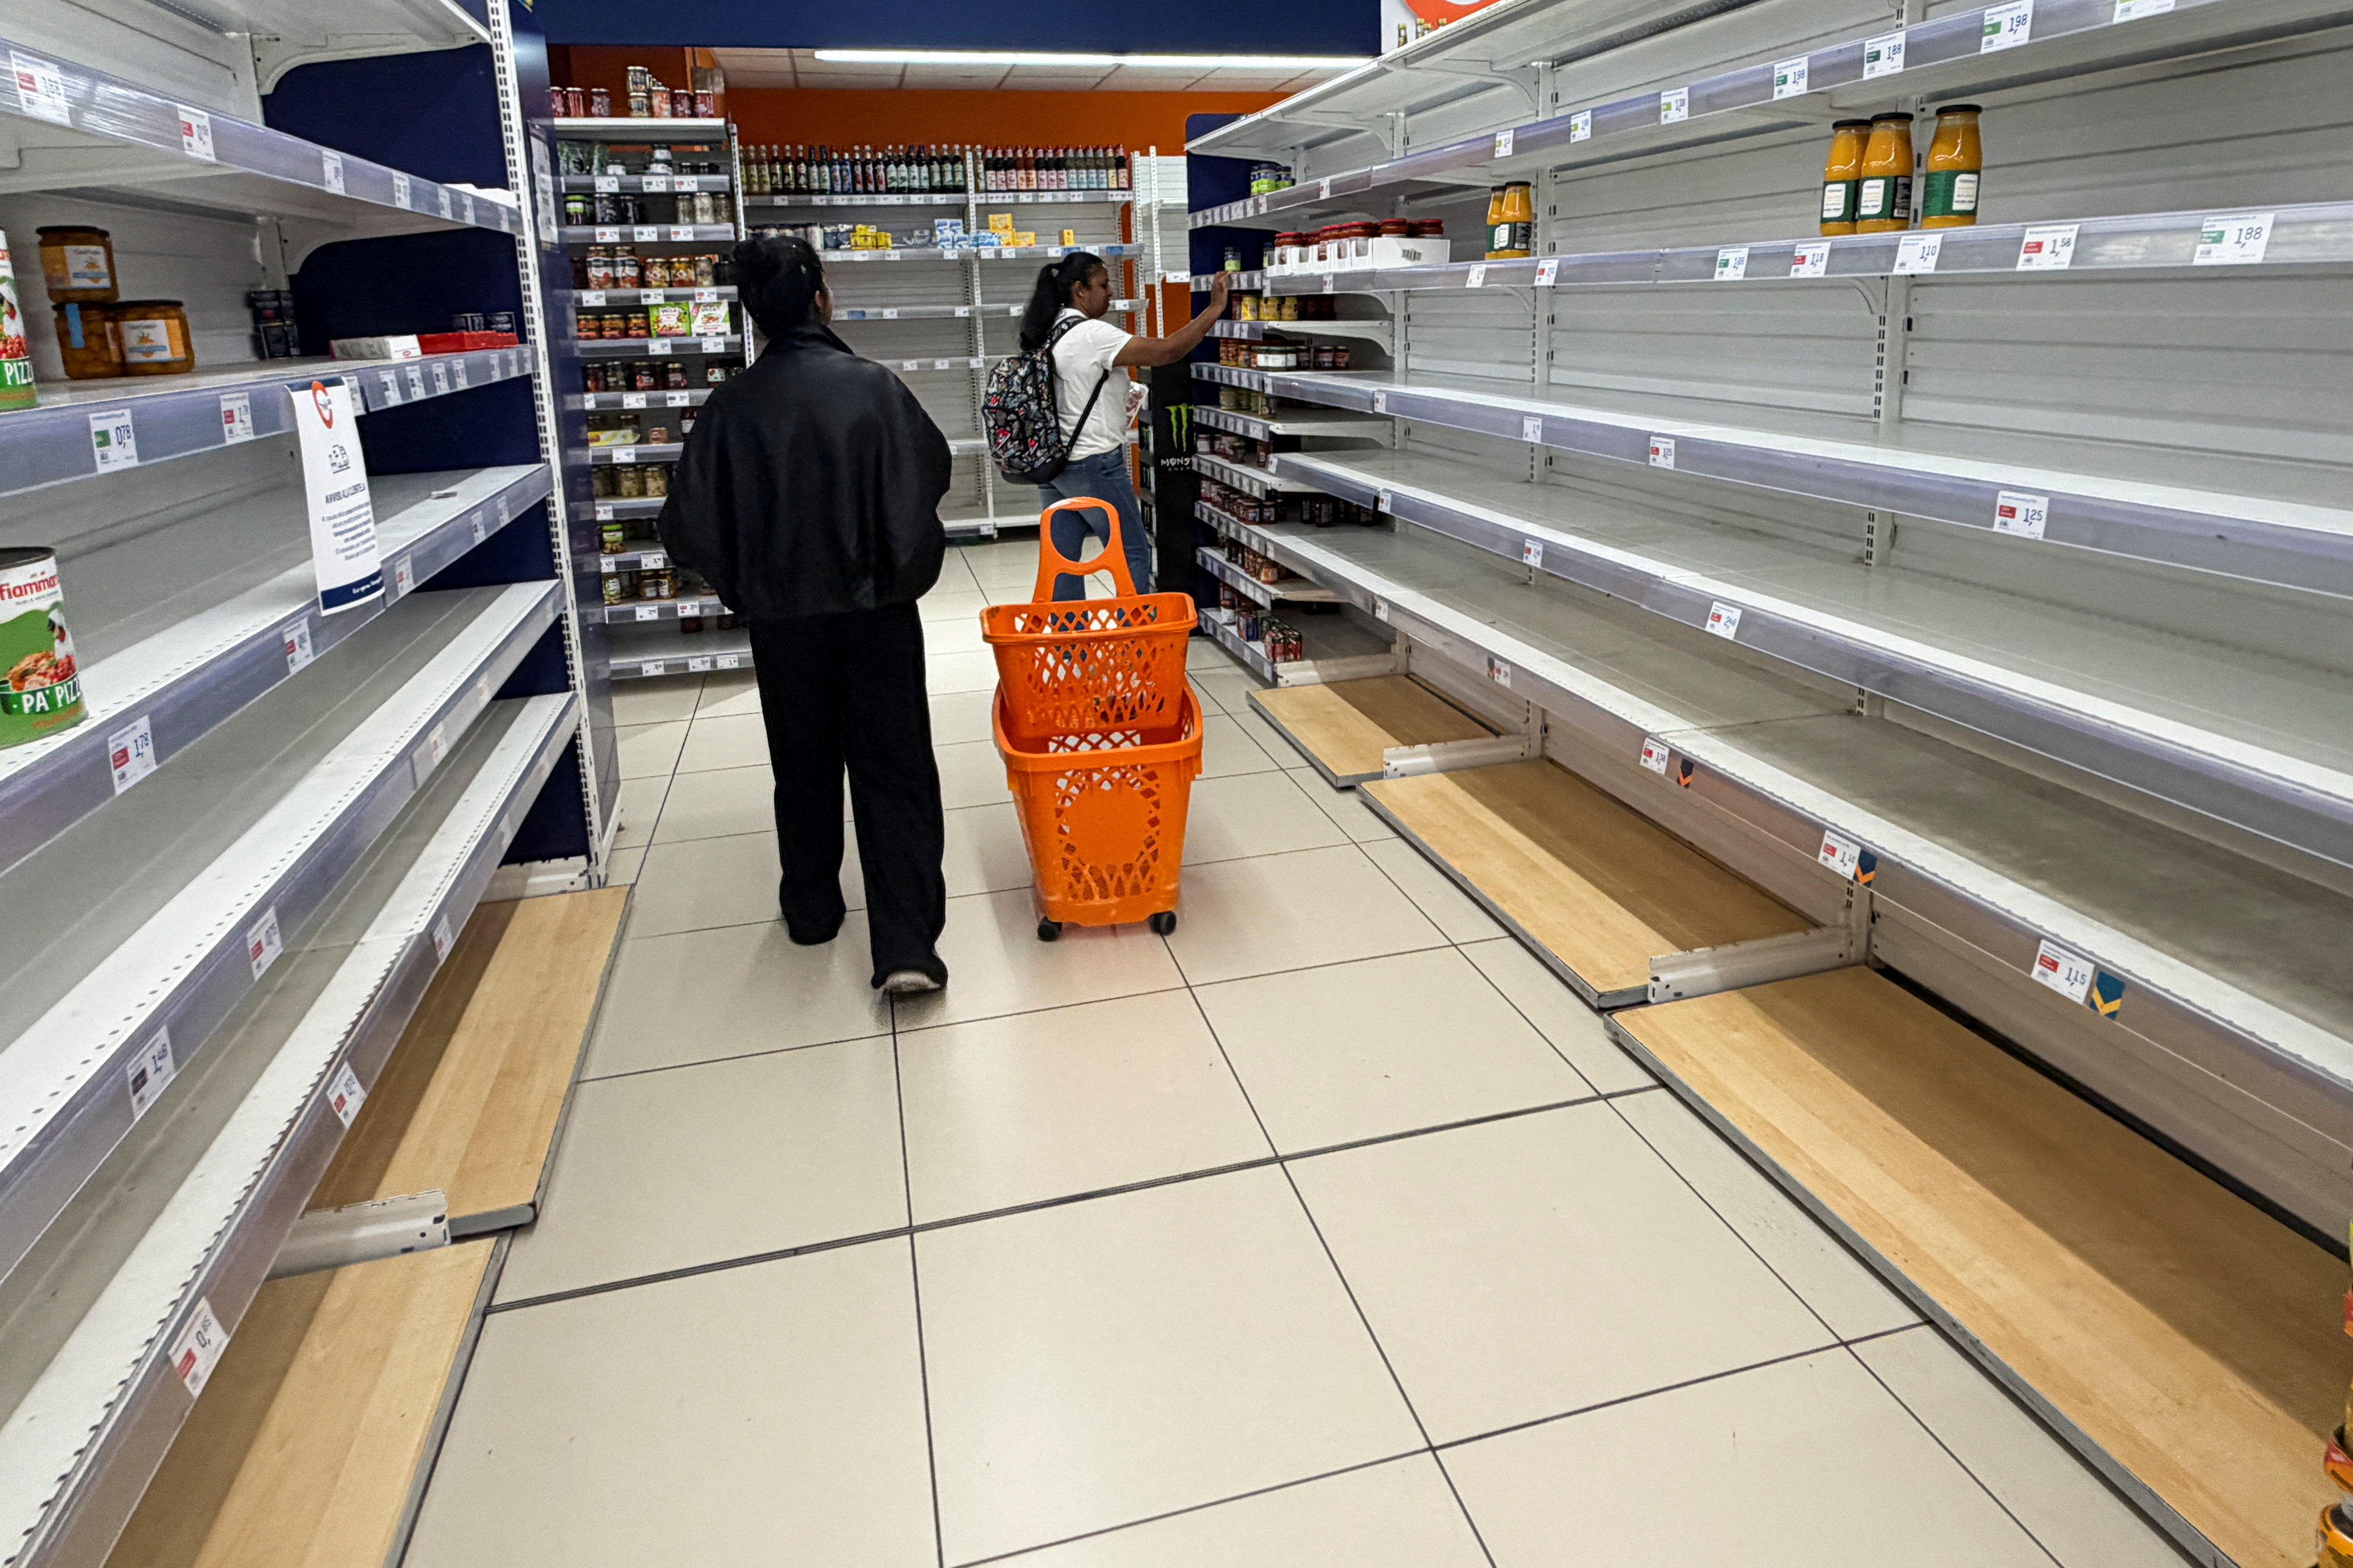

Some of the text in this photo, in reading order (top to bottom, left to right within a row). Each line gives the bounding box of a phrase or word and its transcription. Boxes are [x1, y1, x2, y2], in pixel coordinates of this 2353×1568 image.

[1919, 245, 1937, 263] 1,10
[2049, 237, 2072, 257] 1,58
[4, 362, 34, 386] PIZZ
[1160, 456, 1190, 467] MONS
[2023, 508, 2043, 526] 1,25
[0, 575, 59, 601] fiamma
[55, 677, 82, 708] PIZZ
[2065, 967, 2087, 987] 1,15
